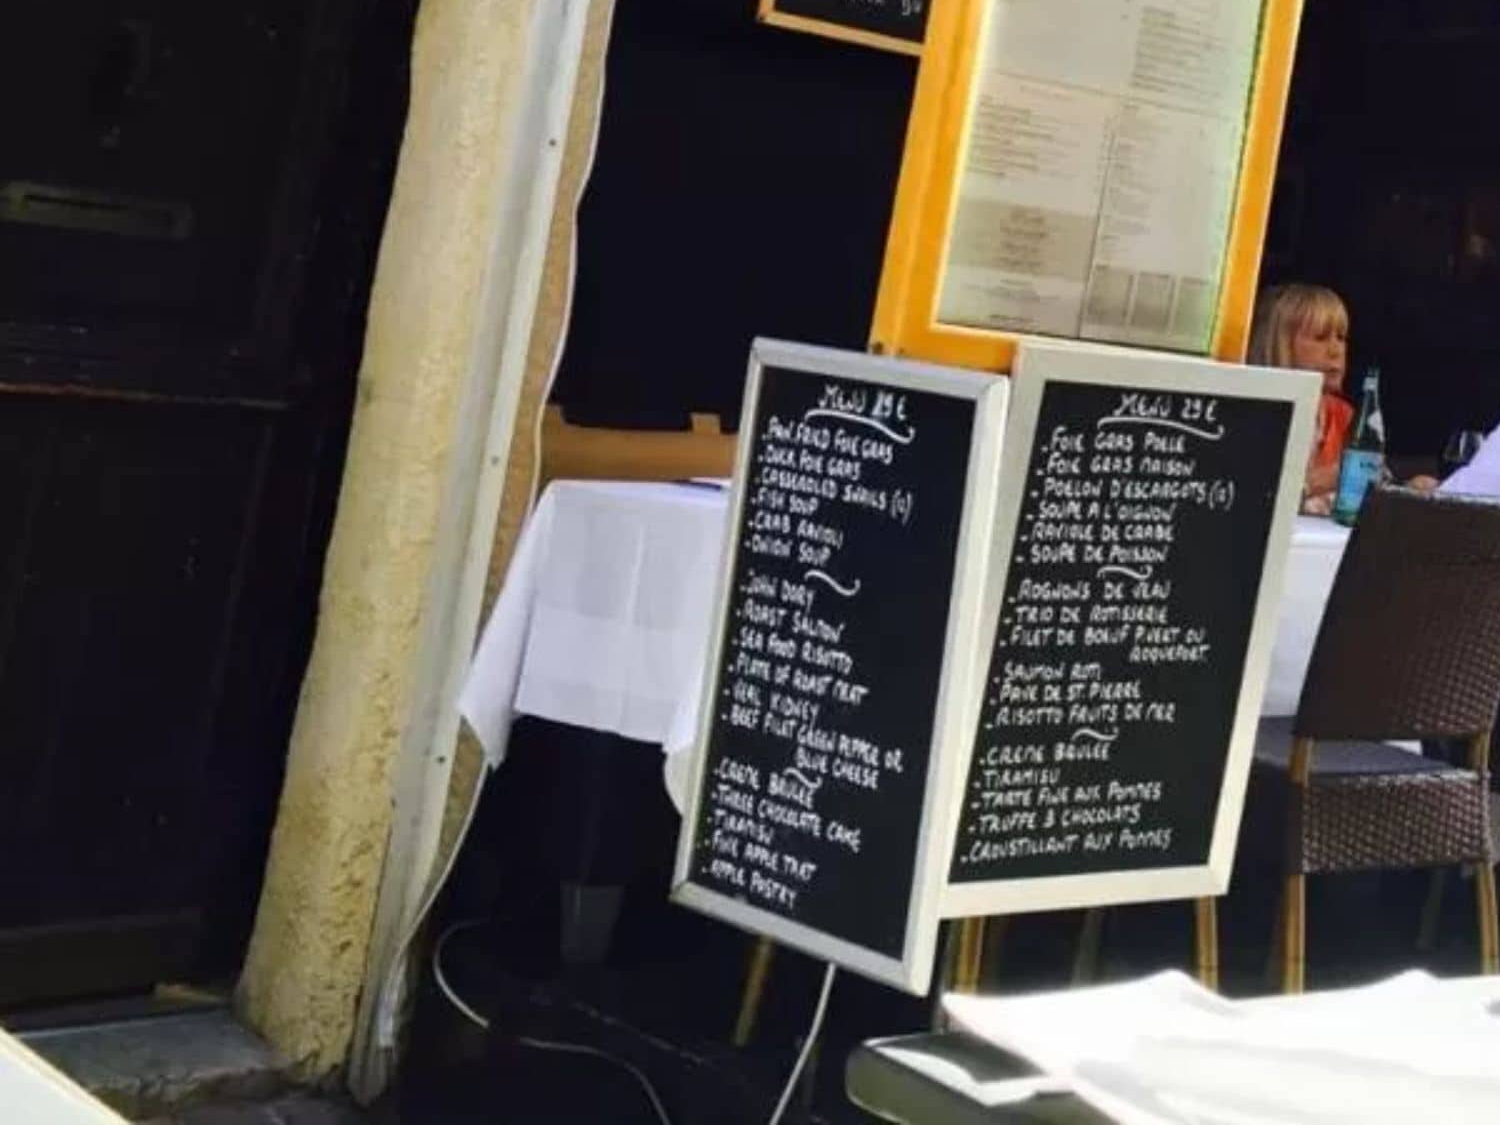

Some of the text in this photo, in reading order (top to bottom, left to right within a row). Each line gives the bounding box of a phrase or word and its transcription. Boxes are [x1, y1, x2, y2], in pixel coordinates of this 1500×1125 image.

[1181, 397, 1202, 420] 29
[1051, 426, 1085, 453] FOIE
[1093, 431, 1134, 452] GRAS
[1047, 451, 1081, 475] FOIE
[1089, 454, 1133, 475] GRAS
[755, 510, 791, 534] CRAB
[1101, 524, 1119, 543] DE
[1123, 524, 1174, 543] CRABE
[1030, 542, 1077, 564] SOUPE
[1084, 544, 1103, 563] DE
[1103, 581, 1124, 601] DE
[1015, 605, 1054, 624] TRIO
[1060, 605, 1081, 624] DE
[1056, 628, 1076, 646] DE
[1044, 684, 1062, 702] DE
[1124, 702, 1144, 721] DE
[981, 788, 1033, 809] TARTE
